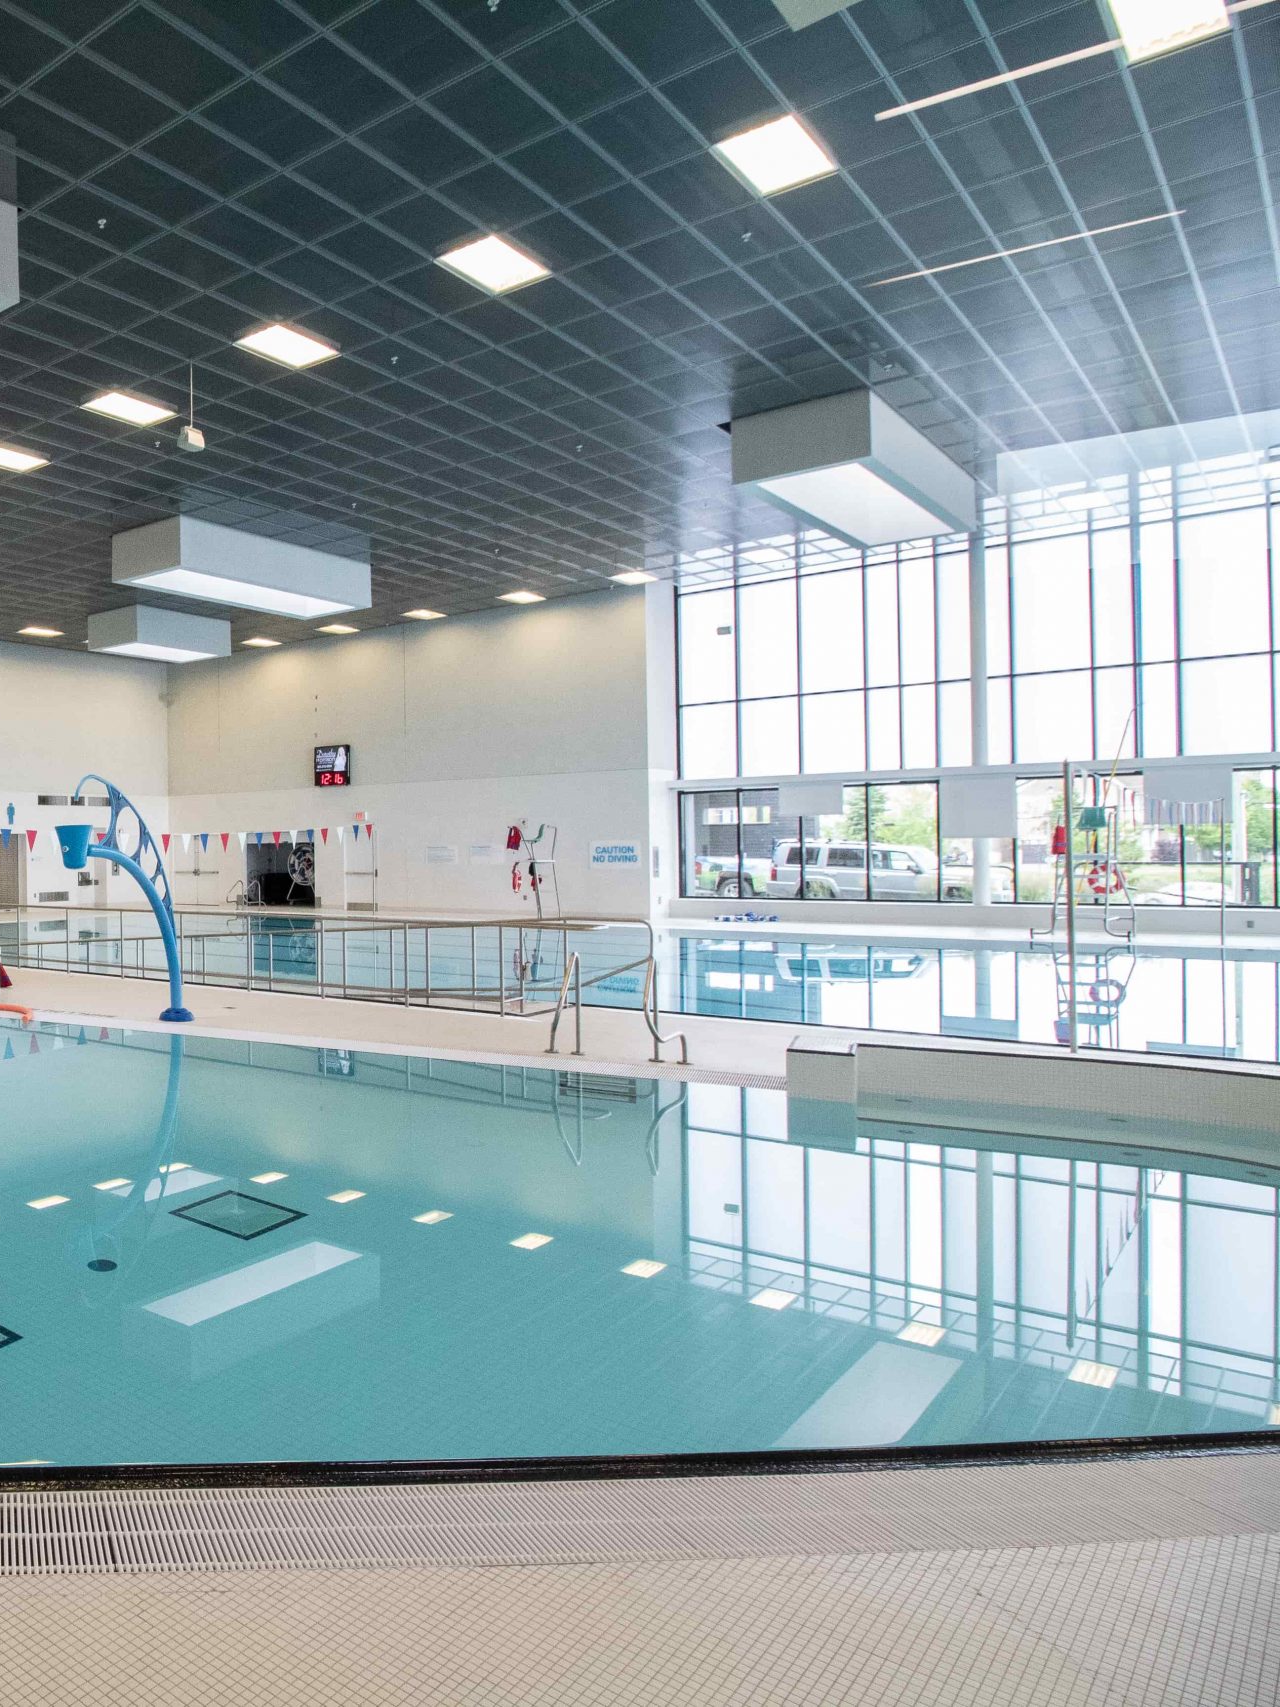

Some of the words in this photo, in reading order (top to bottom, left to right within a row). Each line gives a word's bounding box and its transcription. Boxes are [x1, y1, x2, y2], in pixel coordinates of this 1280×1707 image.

[321, 773, 344, 785] 12:16
[595, 845, 634, 854] CAUTION
[592, 855, 605, 863] NO
[608, 854, 638, 863] DIVING
